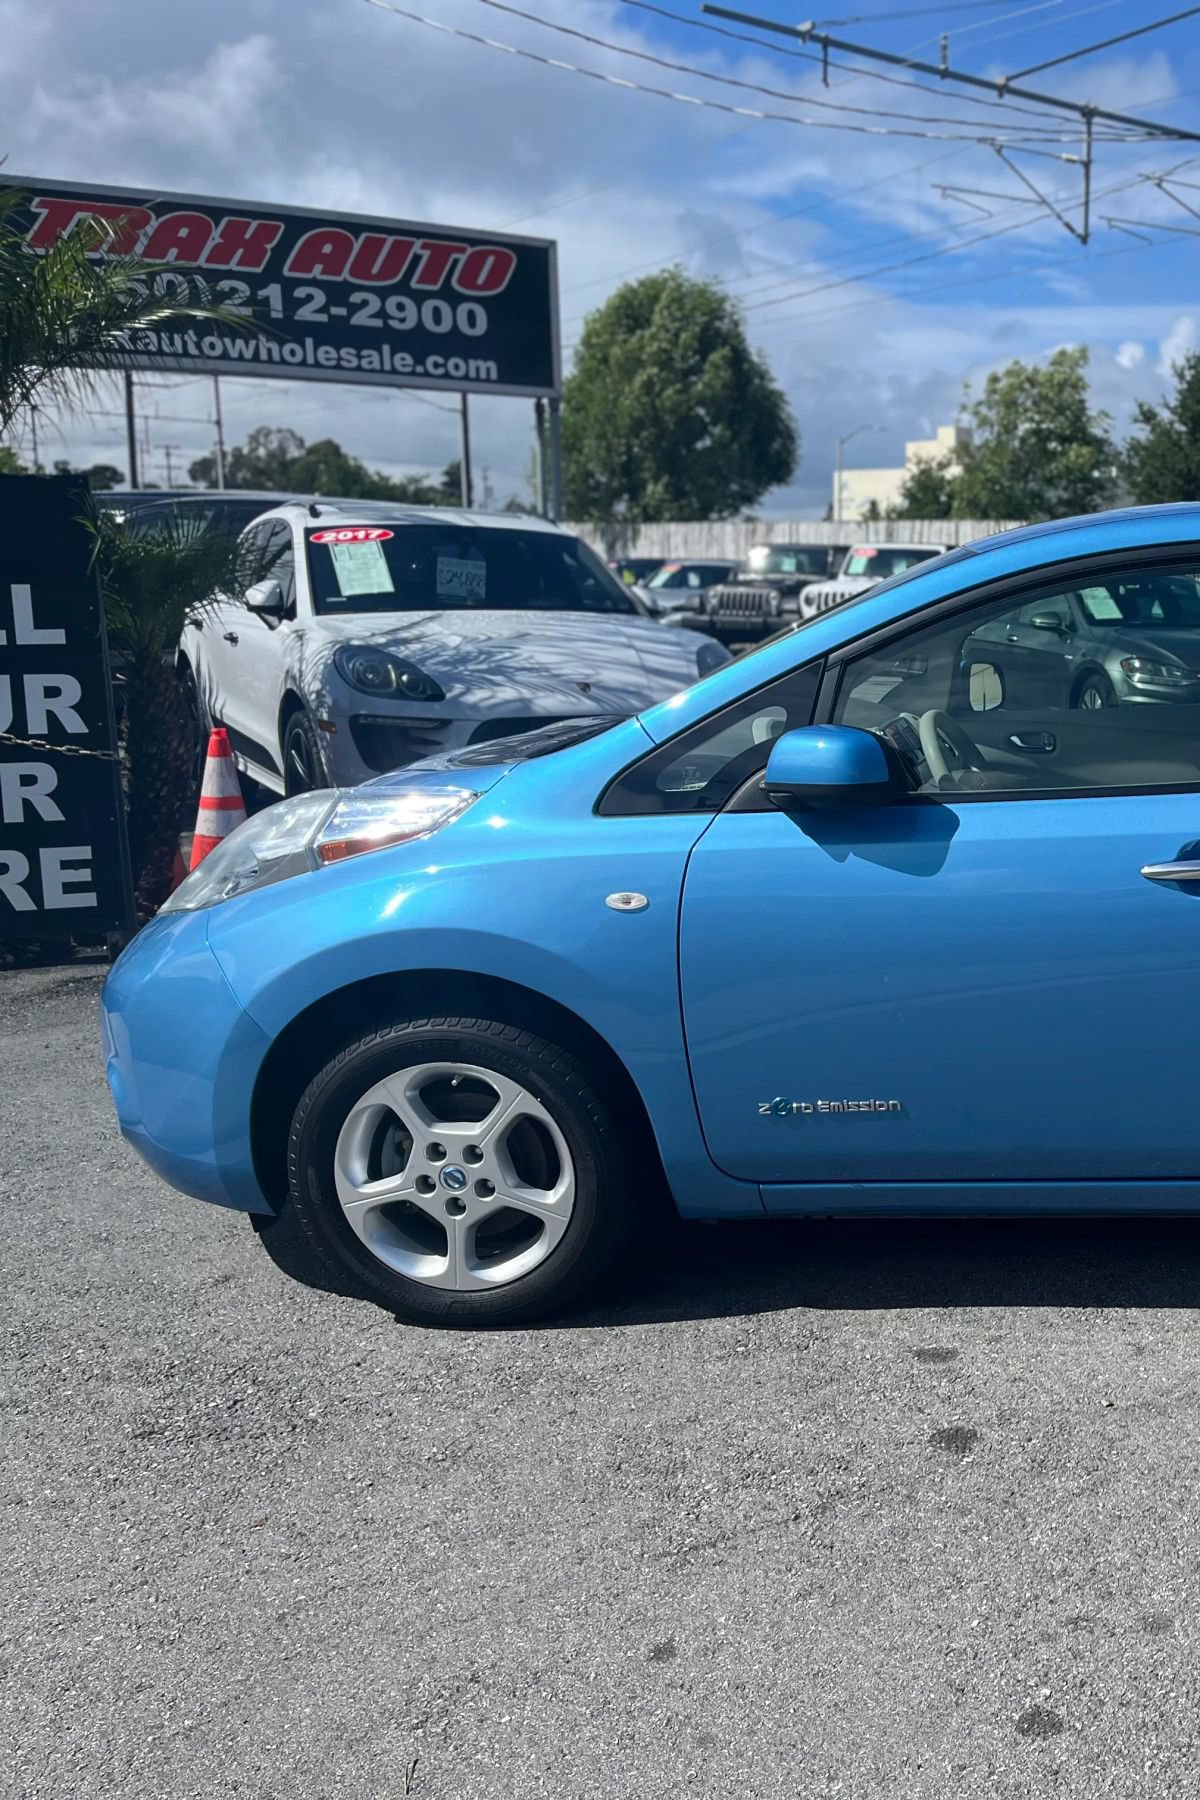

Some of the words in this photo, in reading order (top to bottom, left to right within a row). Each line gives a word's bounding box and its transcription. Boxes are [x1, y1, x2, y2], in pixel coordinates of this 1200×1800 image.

[22, 197, 285, 273] TRAX
[283, 227, 517, 297] AUTO
[320, 530, 384, 542] 2017
[0, 584, 66, 645] L
[0, 673, 89, 735] R
[817, 1098, 901, 1113] Emission
